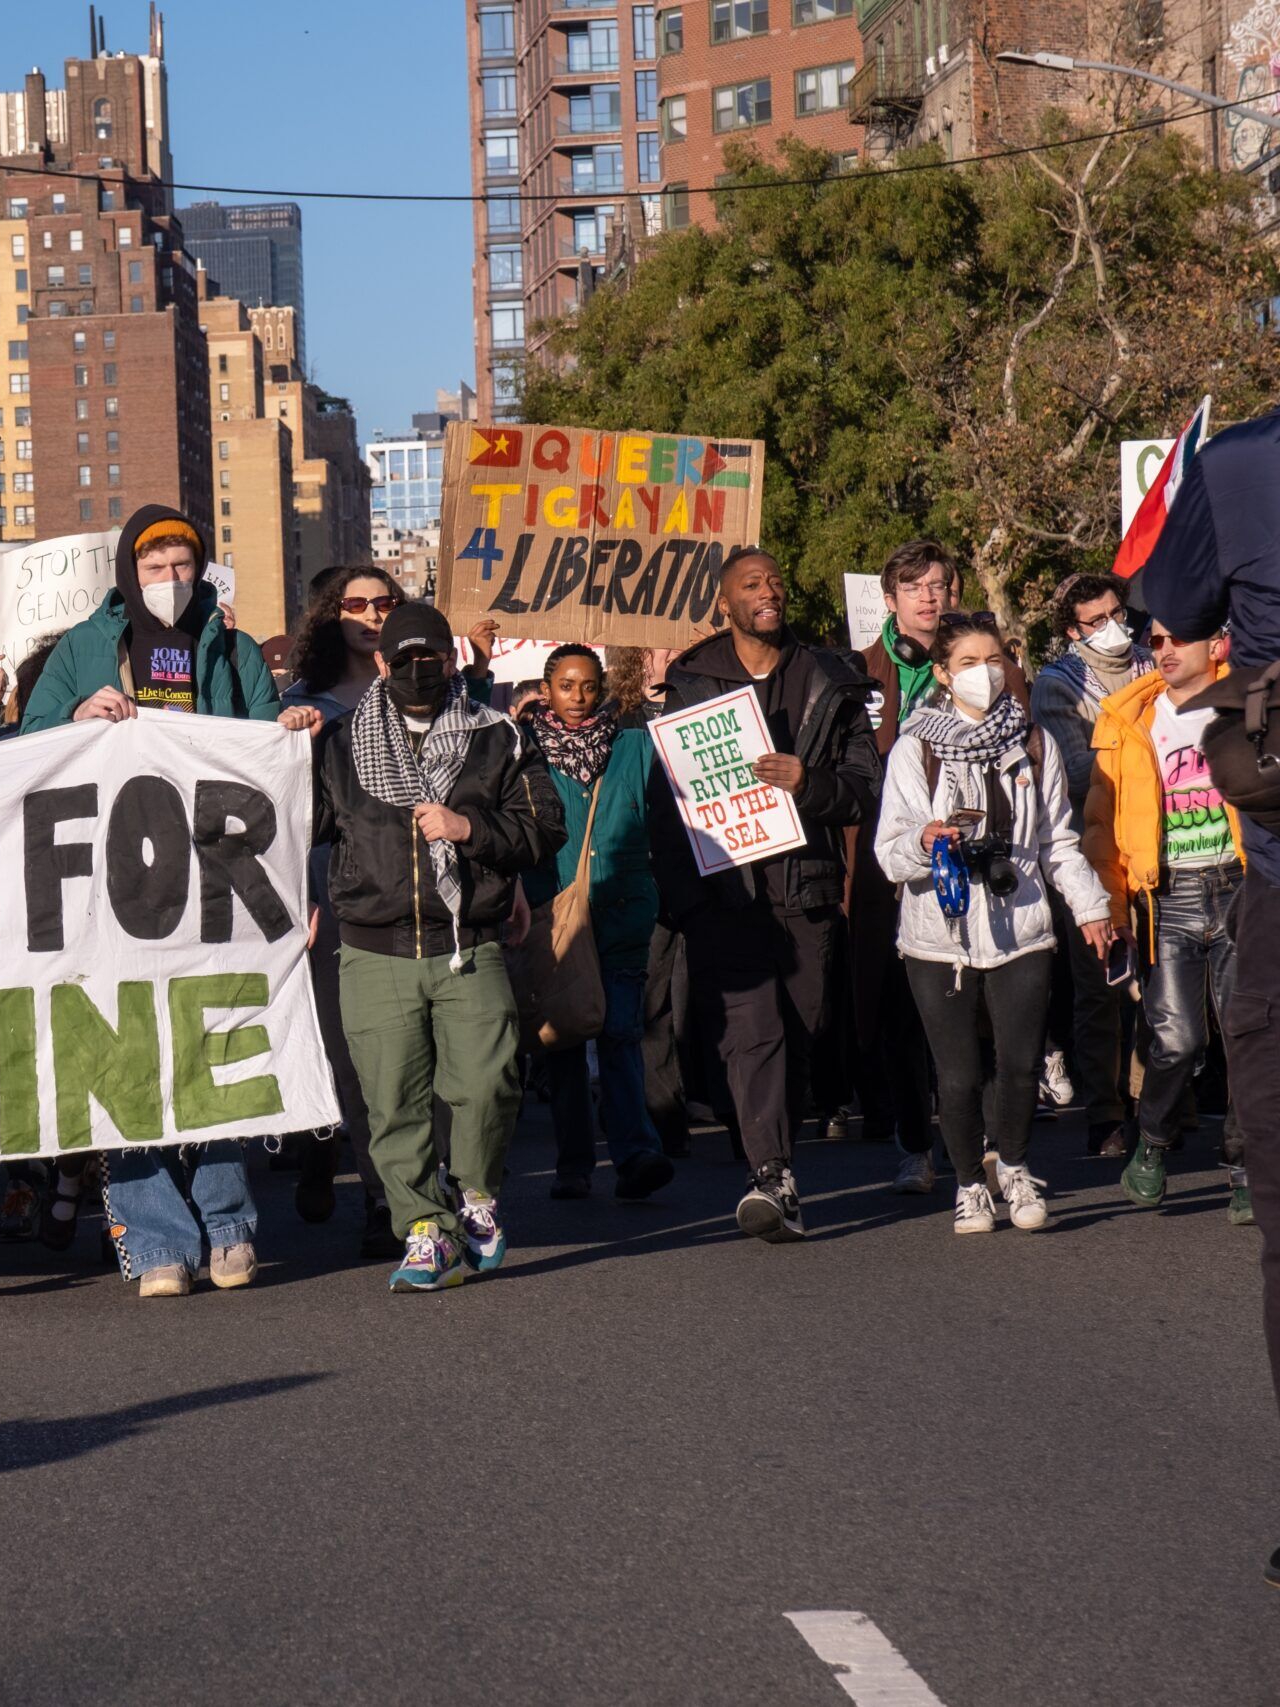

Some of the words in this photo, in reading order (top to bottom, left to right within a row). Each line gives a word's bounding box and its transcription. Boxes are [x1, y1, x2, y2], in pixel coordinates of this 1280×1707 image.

[532, 429, 704, 486] QUEER
[470, 483, 726, 534] TIGRAYAN
[16, 547, 81, 590] STOP
[86, 545, 117, 574] TH
[456, 527, 504, 581] 4
[207, 572, 231, 594] LIVE
[16, 586, 103, 626] GENOC
[855, 605, 877, 616] HOW
[150, 647, 191, 661] JORJ
[143, 686, 158, 698] Live
[174, 672, 191, 680] foun
[675, 708, 742, 750] FROM
[693, 738, 743, 773] THE
[696, 801, 727, 829] TO
[729, 784, 779, 819] THE
[724, 818, 770, 851] SEA
[23, 774, 296, 954] FOR
